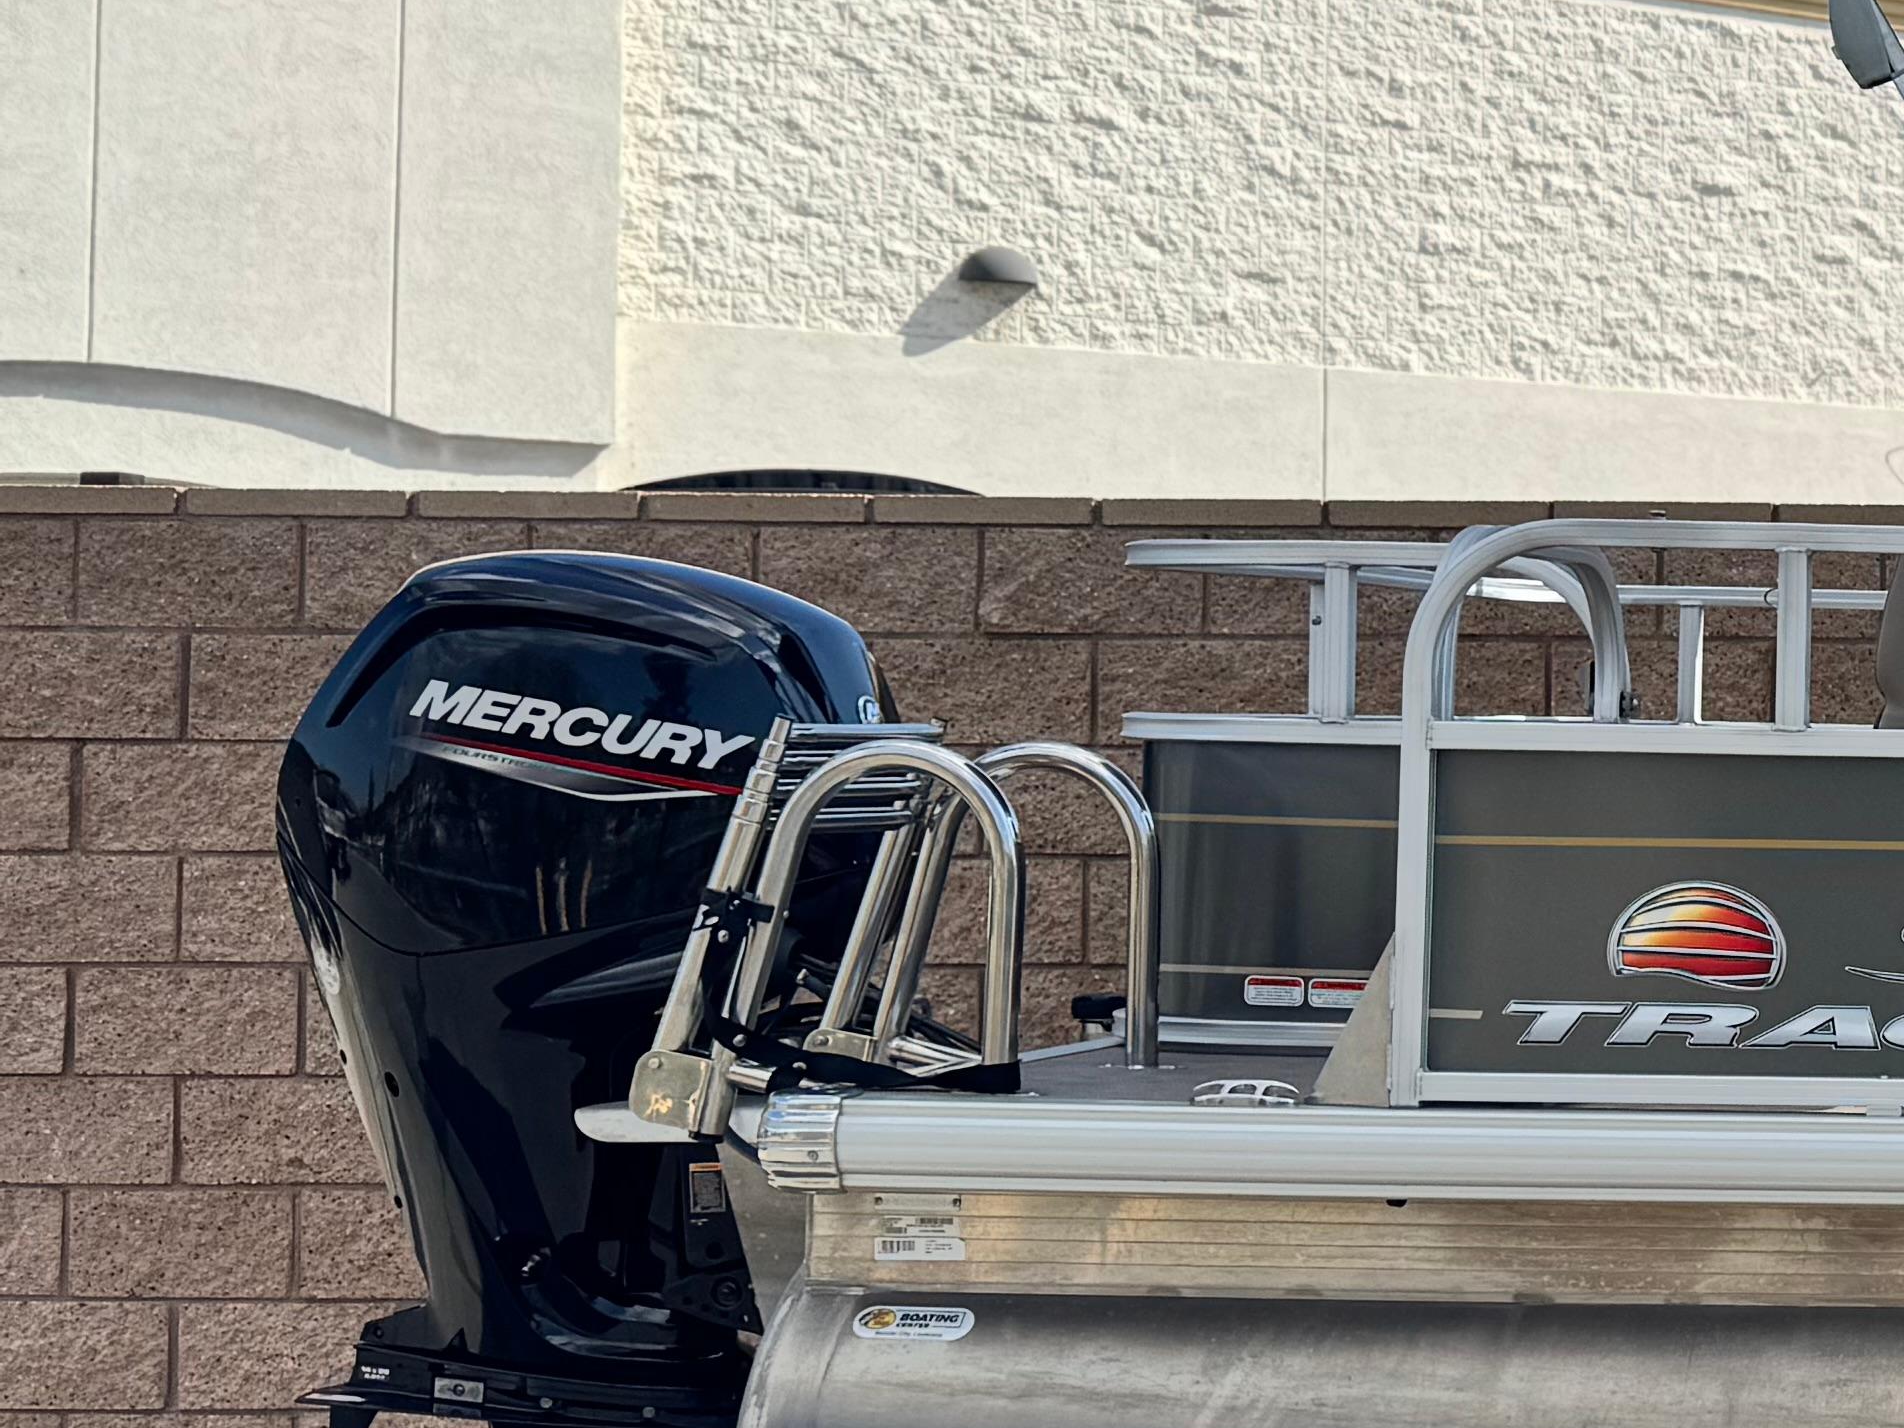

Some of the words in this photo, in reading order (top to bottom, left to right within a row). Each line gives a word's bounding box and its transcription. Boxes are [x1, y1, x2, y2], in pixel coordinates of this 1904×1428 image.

[409, 679, 755, 769] MERCURY
[443, 745, 549, 770] FOURSTRO
[900, 1313, 960, 1323] BOATING
